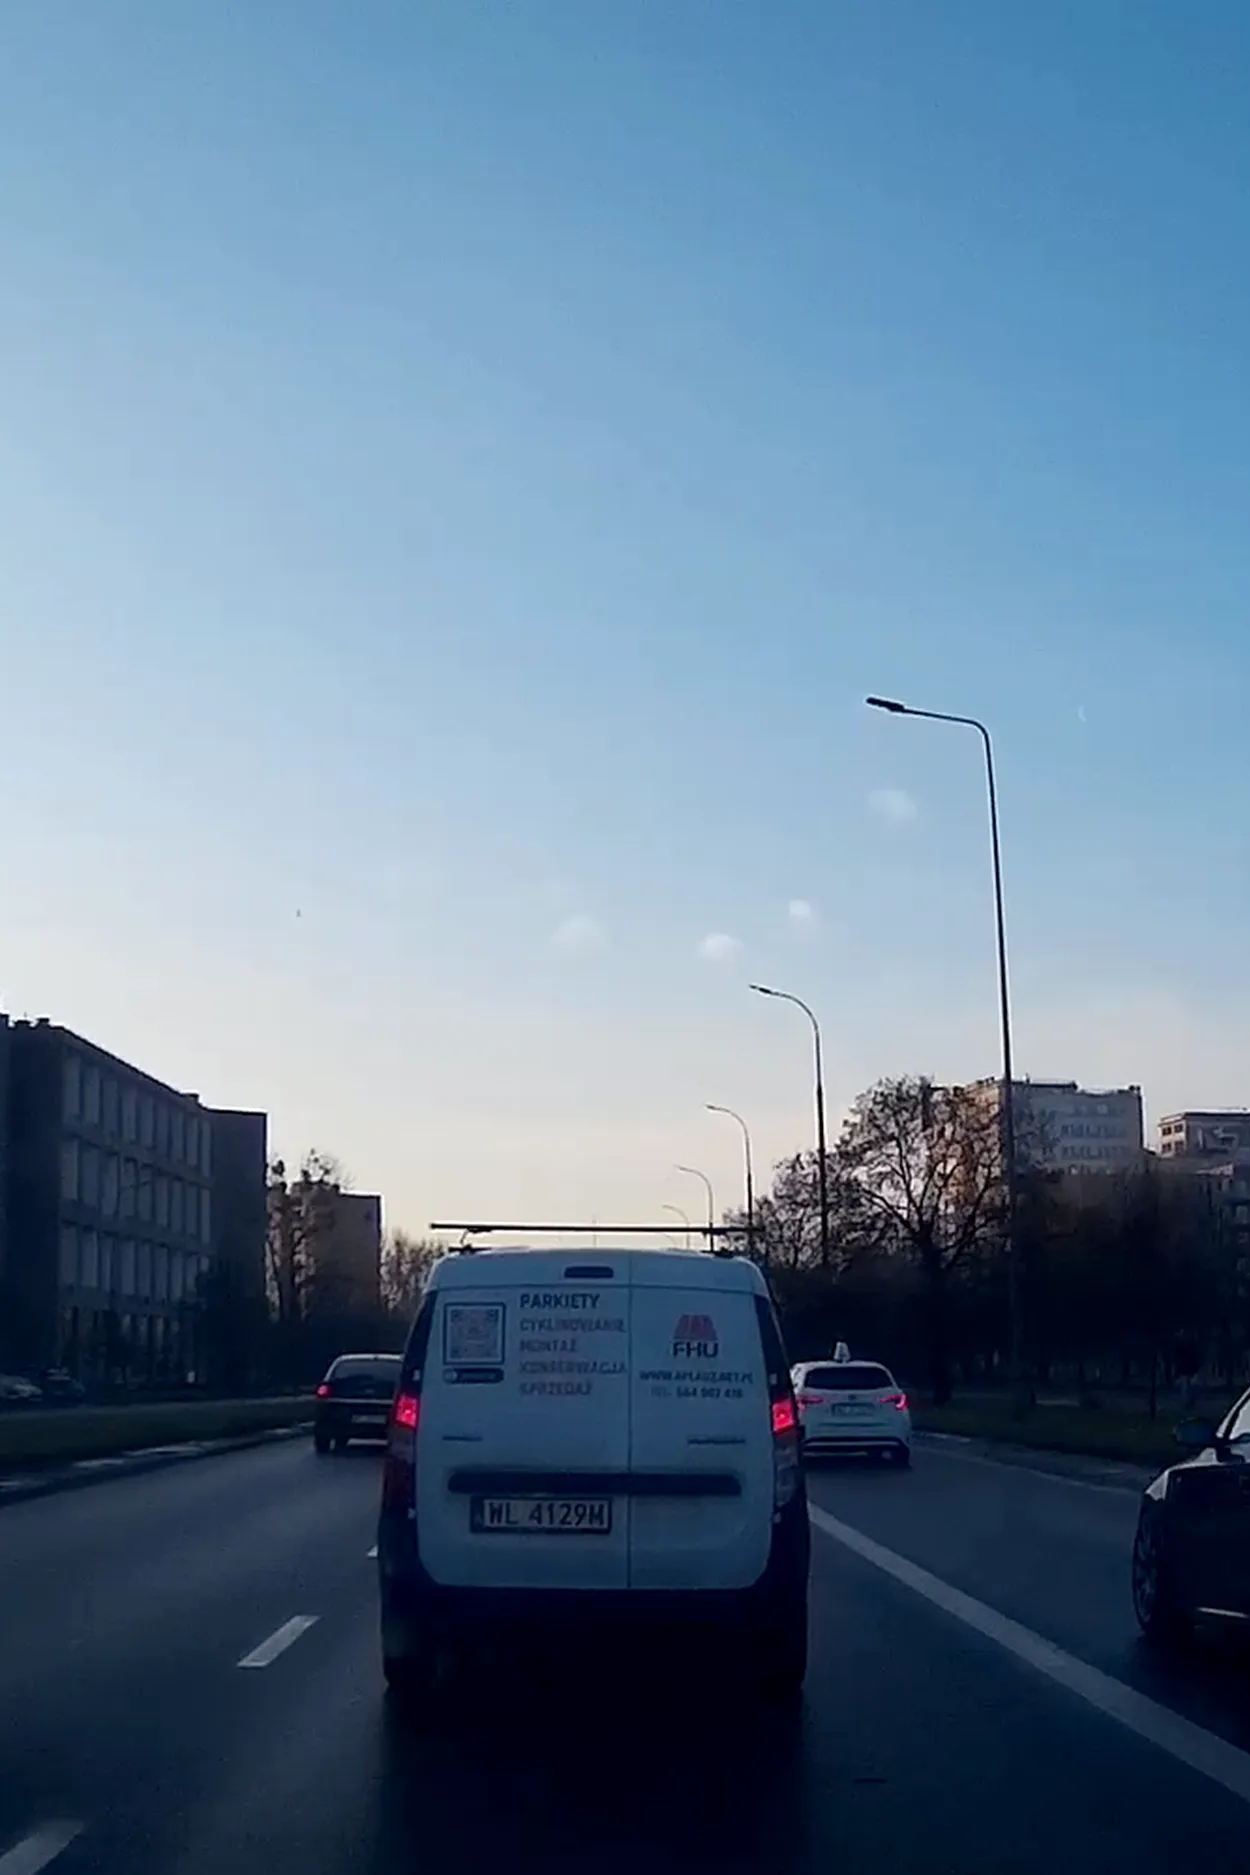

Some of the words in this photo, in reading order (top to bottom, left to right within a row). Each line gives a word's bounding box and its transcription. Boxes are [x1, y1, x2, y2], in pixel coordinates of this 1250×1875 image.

[519, 1292, 601, 1309] PARKIETY
[672, 1341, 719, 1358] FHU
[488, 1501, 519, 1525] WL
[528, 1503, 605, 1526] 4129M
